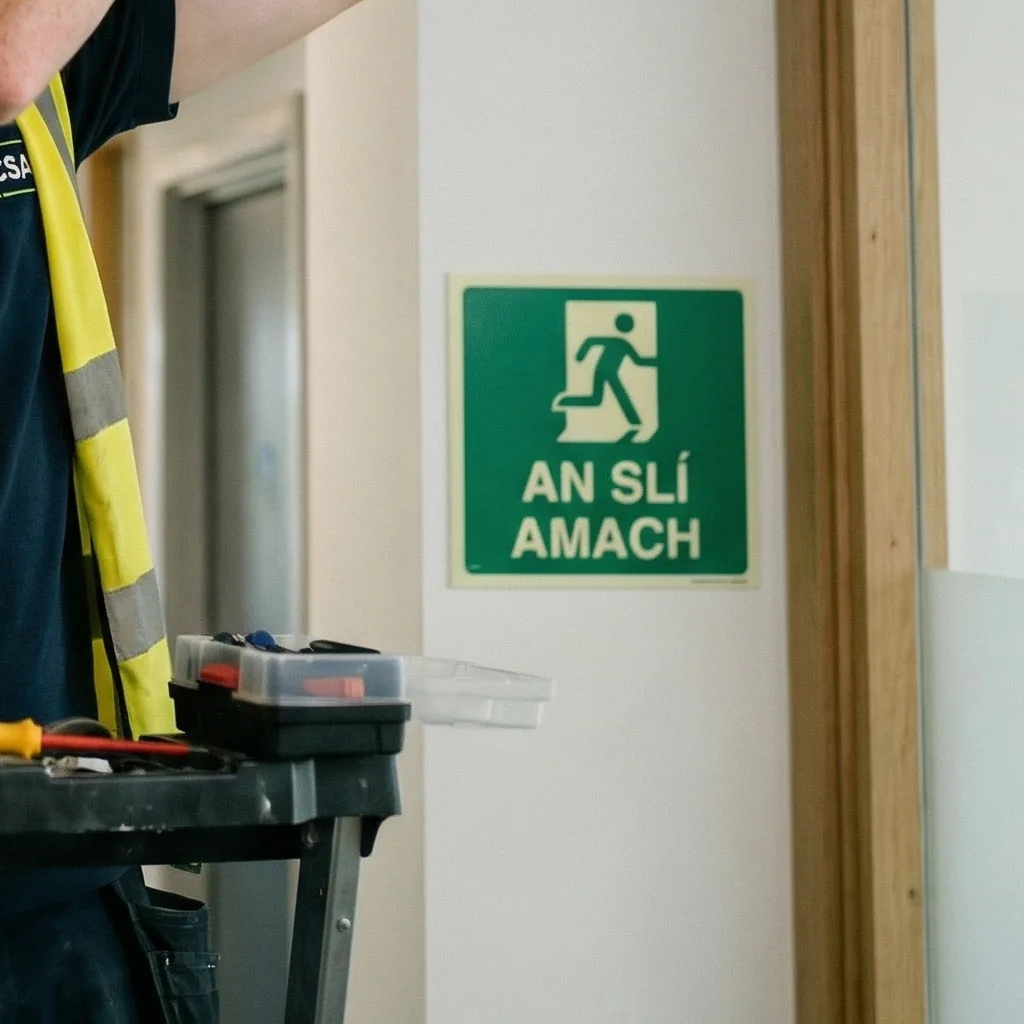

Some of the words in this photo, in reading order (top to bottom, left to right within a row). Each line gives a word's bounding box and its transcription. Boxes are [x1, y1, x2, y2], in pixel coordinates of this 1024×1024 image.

[522, 461, 595, 503] AN
[611, 451, 690, 504] SLÍ
[511, 517, 701, 560] AMACH
